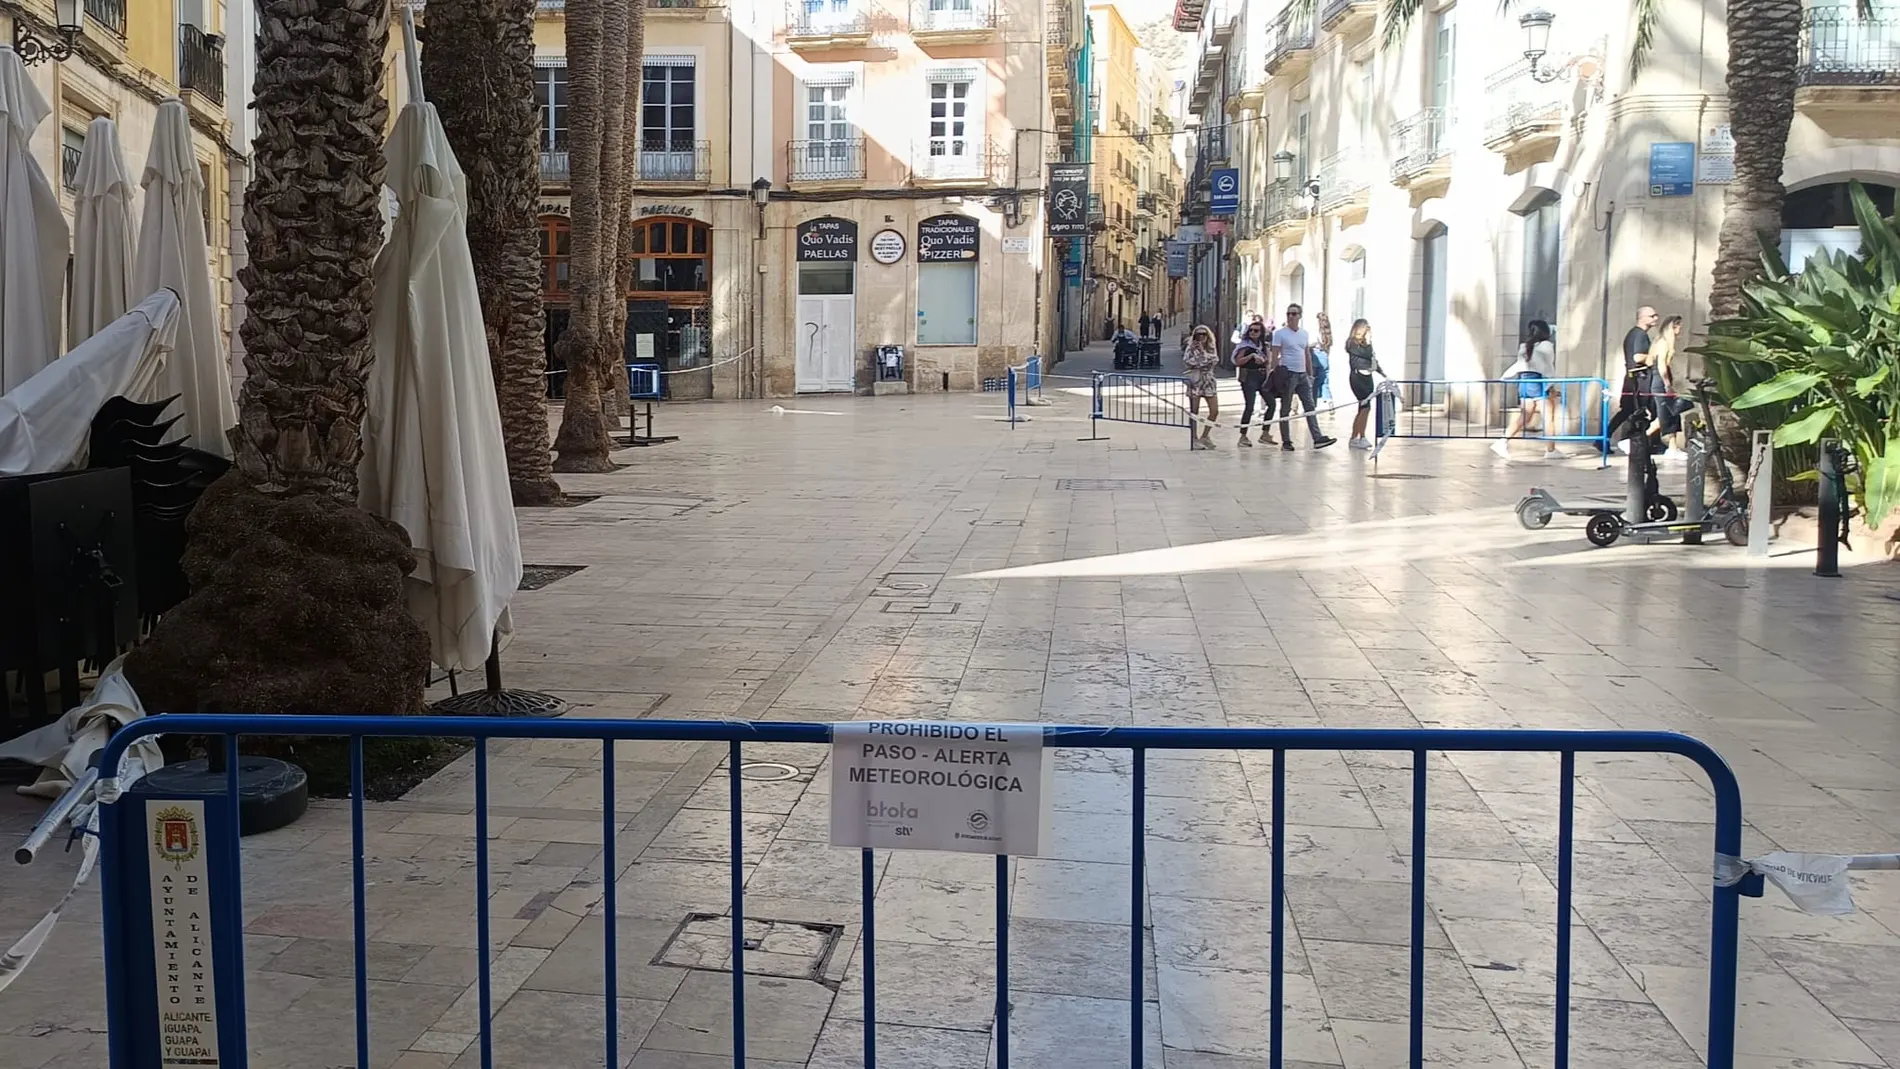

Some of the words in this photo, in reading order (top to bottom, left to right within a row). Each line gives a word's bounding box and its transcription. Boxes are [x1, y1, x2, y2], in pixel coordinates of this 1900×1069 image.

[537, 204, 569, 214] APAS
[641, 204, 694, 216] PAELLAS
[818, 222, 840, 230] TAPAS
[801, 232, 824, 246] Quo
[825, 234, 854, 244] Vadis
[921, 235, 944, 246] Quo
[945, 235, 975, 245] Vadis
[804, 249, 848, 259] PAELLAS
[868, 722, 979, 740] PROHIBIDO
[985, 727, 1008, 742] EL
[863, 743, 916, 760] PASO
[934, 749, 1012, 766] ALERTA
[849, 767, 1023, 793] METEOROLÓGICA
[867, 801, 918, 818] brota
[186, 875, 198, 895] DE
[162, 875, 180, 1004] AYUNTAMIENTO
[189, 912, 205, 1004] ALICANTE
[165, 1036, 199, 1045] GUAPA
[165, 1047, 171, 1056] Y
[174, 1047, 211, 1057] GUAPA!
